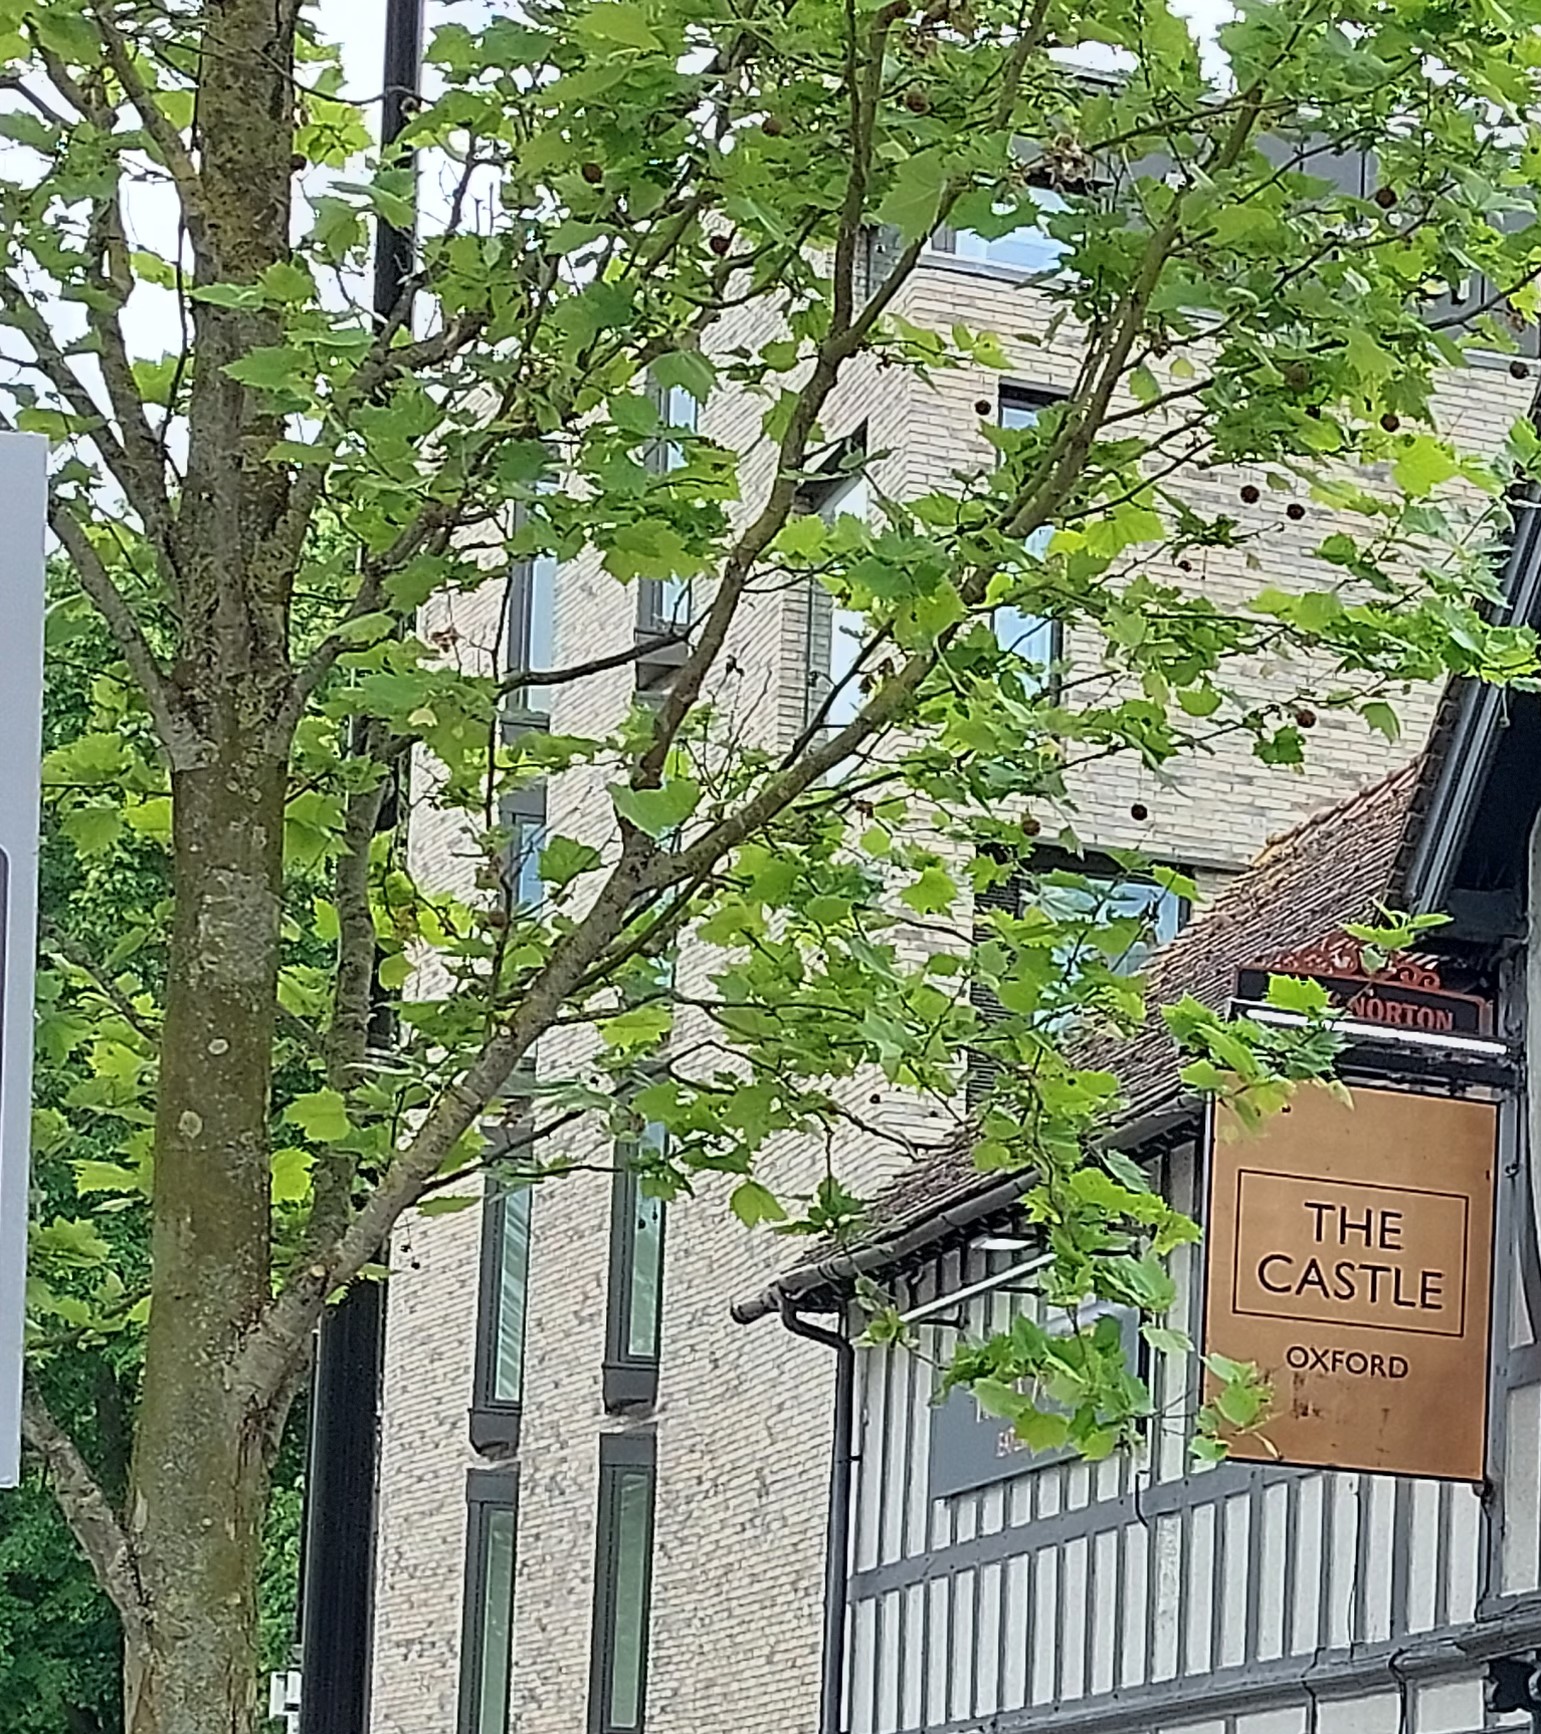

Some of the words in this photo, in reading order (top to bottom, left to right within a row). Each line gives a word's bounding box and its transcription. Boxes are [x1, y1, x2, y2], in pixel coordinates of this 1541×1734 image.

[1352, 997, 1454, 1032] NORTON
[1304, 1202, 1404, 1251] THE
[1257, 1254, 1445, 1310] CASTLE
[1286, 1346, 1410, 1380] OXFORD
